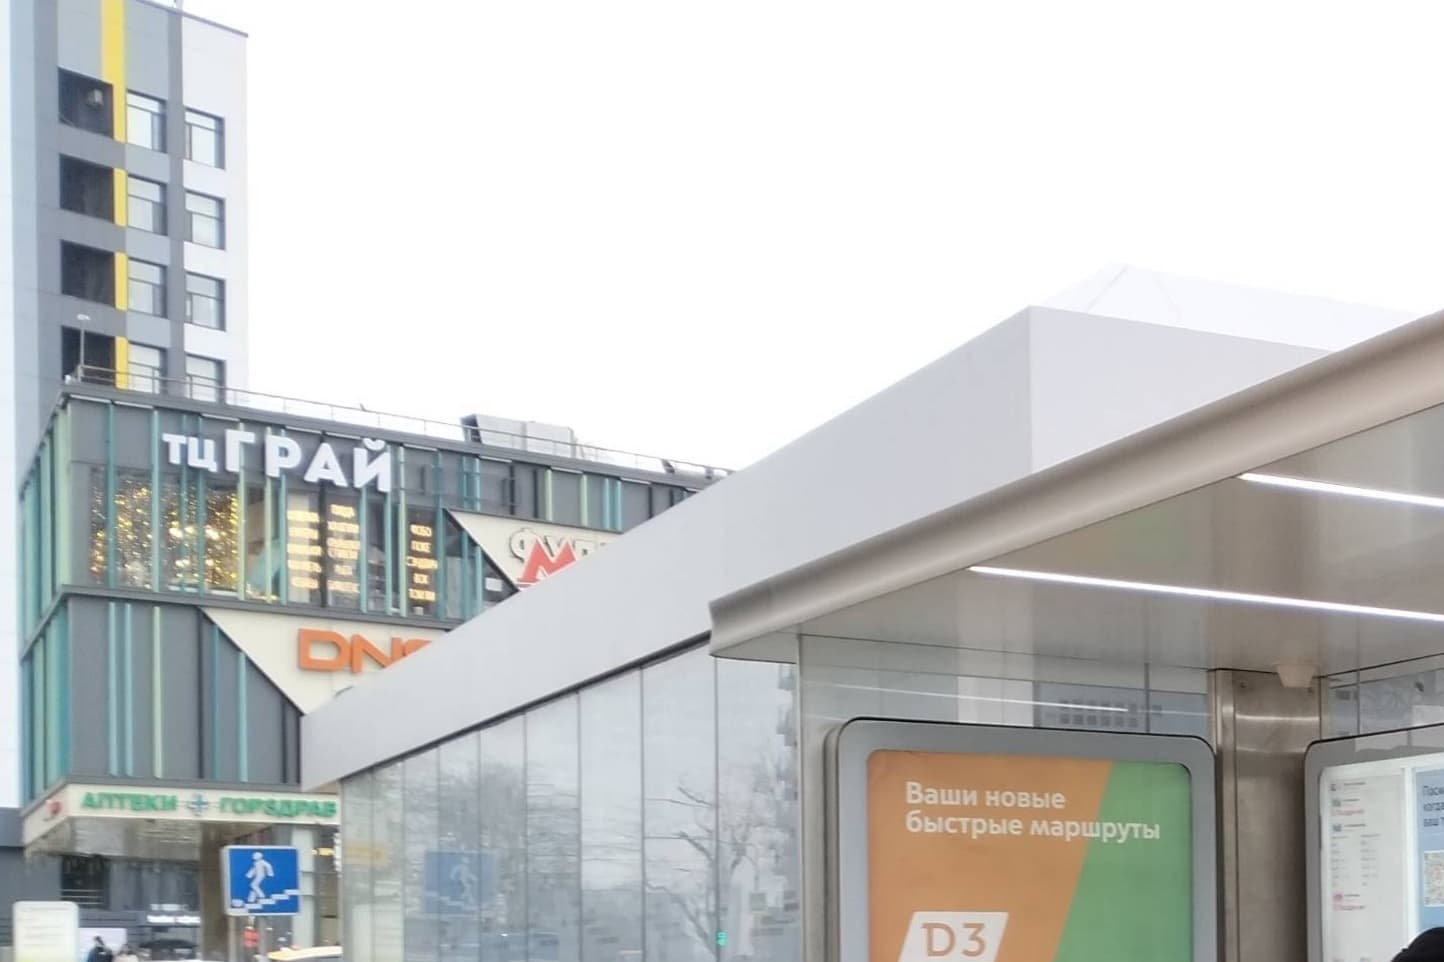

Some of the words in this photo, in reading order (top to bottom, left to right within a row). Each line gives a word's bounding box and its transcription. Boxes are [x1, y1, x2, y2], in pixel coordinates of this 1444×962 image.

[225, 428, 392, 493] ГРАЙ
[81, 791, 178, 812] АПТЕКИ
[905, 781, 978, 807] Ваши
[985, 789, 1067, 809] новые
[905, 809, 1024, 840] быстрые
[1029, 818, 1161, 843] маршруты
[921, 922, 987, 958] D3
